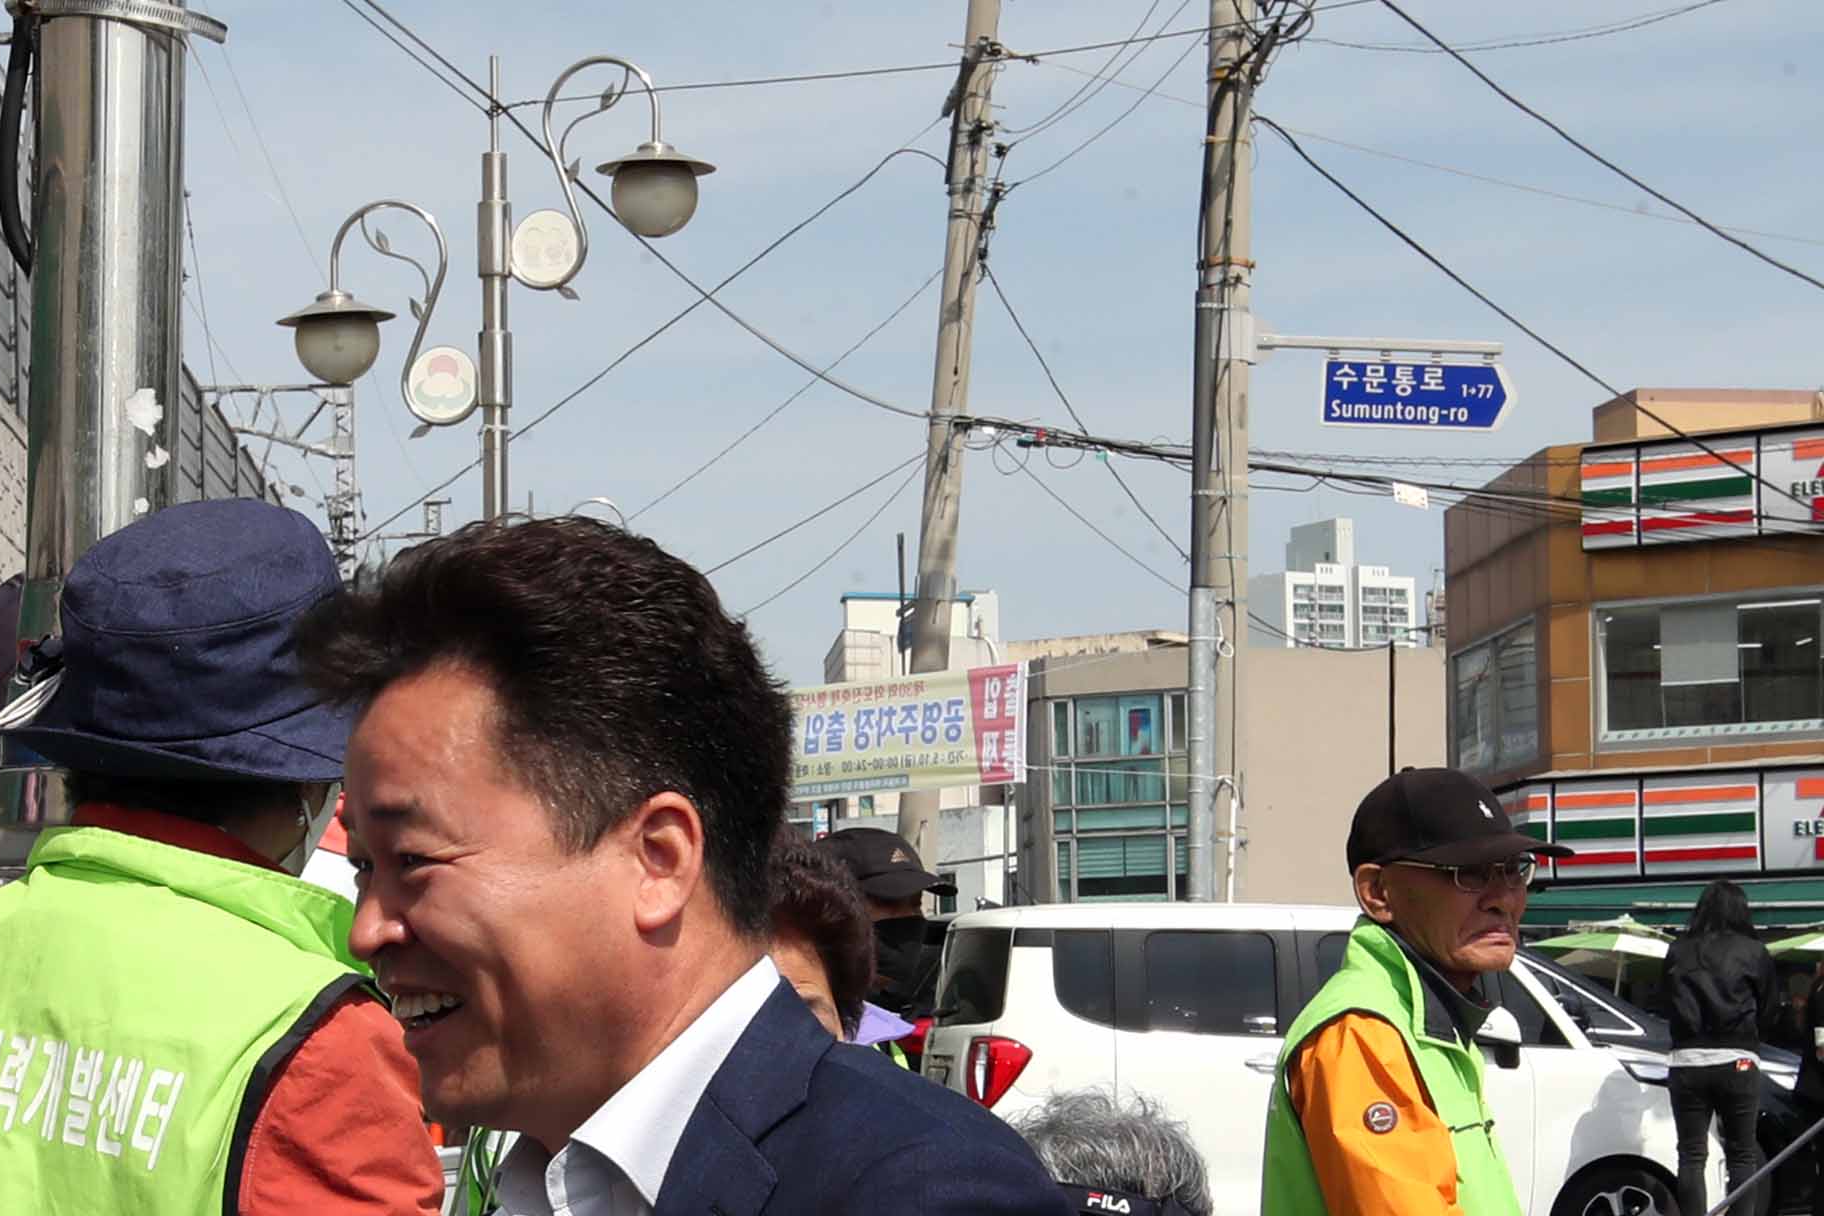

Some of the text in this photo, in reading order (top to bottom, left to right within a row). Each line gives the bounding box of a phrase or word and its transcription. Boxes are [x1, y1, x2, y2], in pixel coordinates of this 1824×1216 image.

[1333, 364, 1446, 397] 수문통로
[1331, 399, 1469, 425] Sumuntong-ro
[1790, 480, 1824, 497] ELE
[1086, 1191, 1131, 1215] FILA
